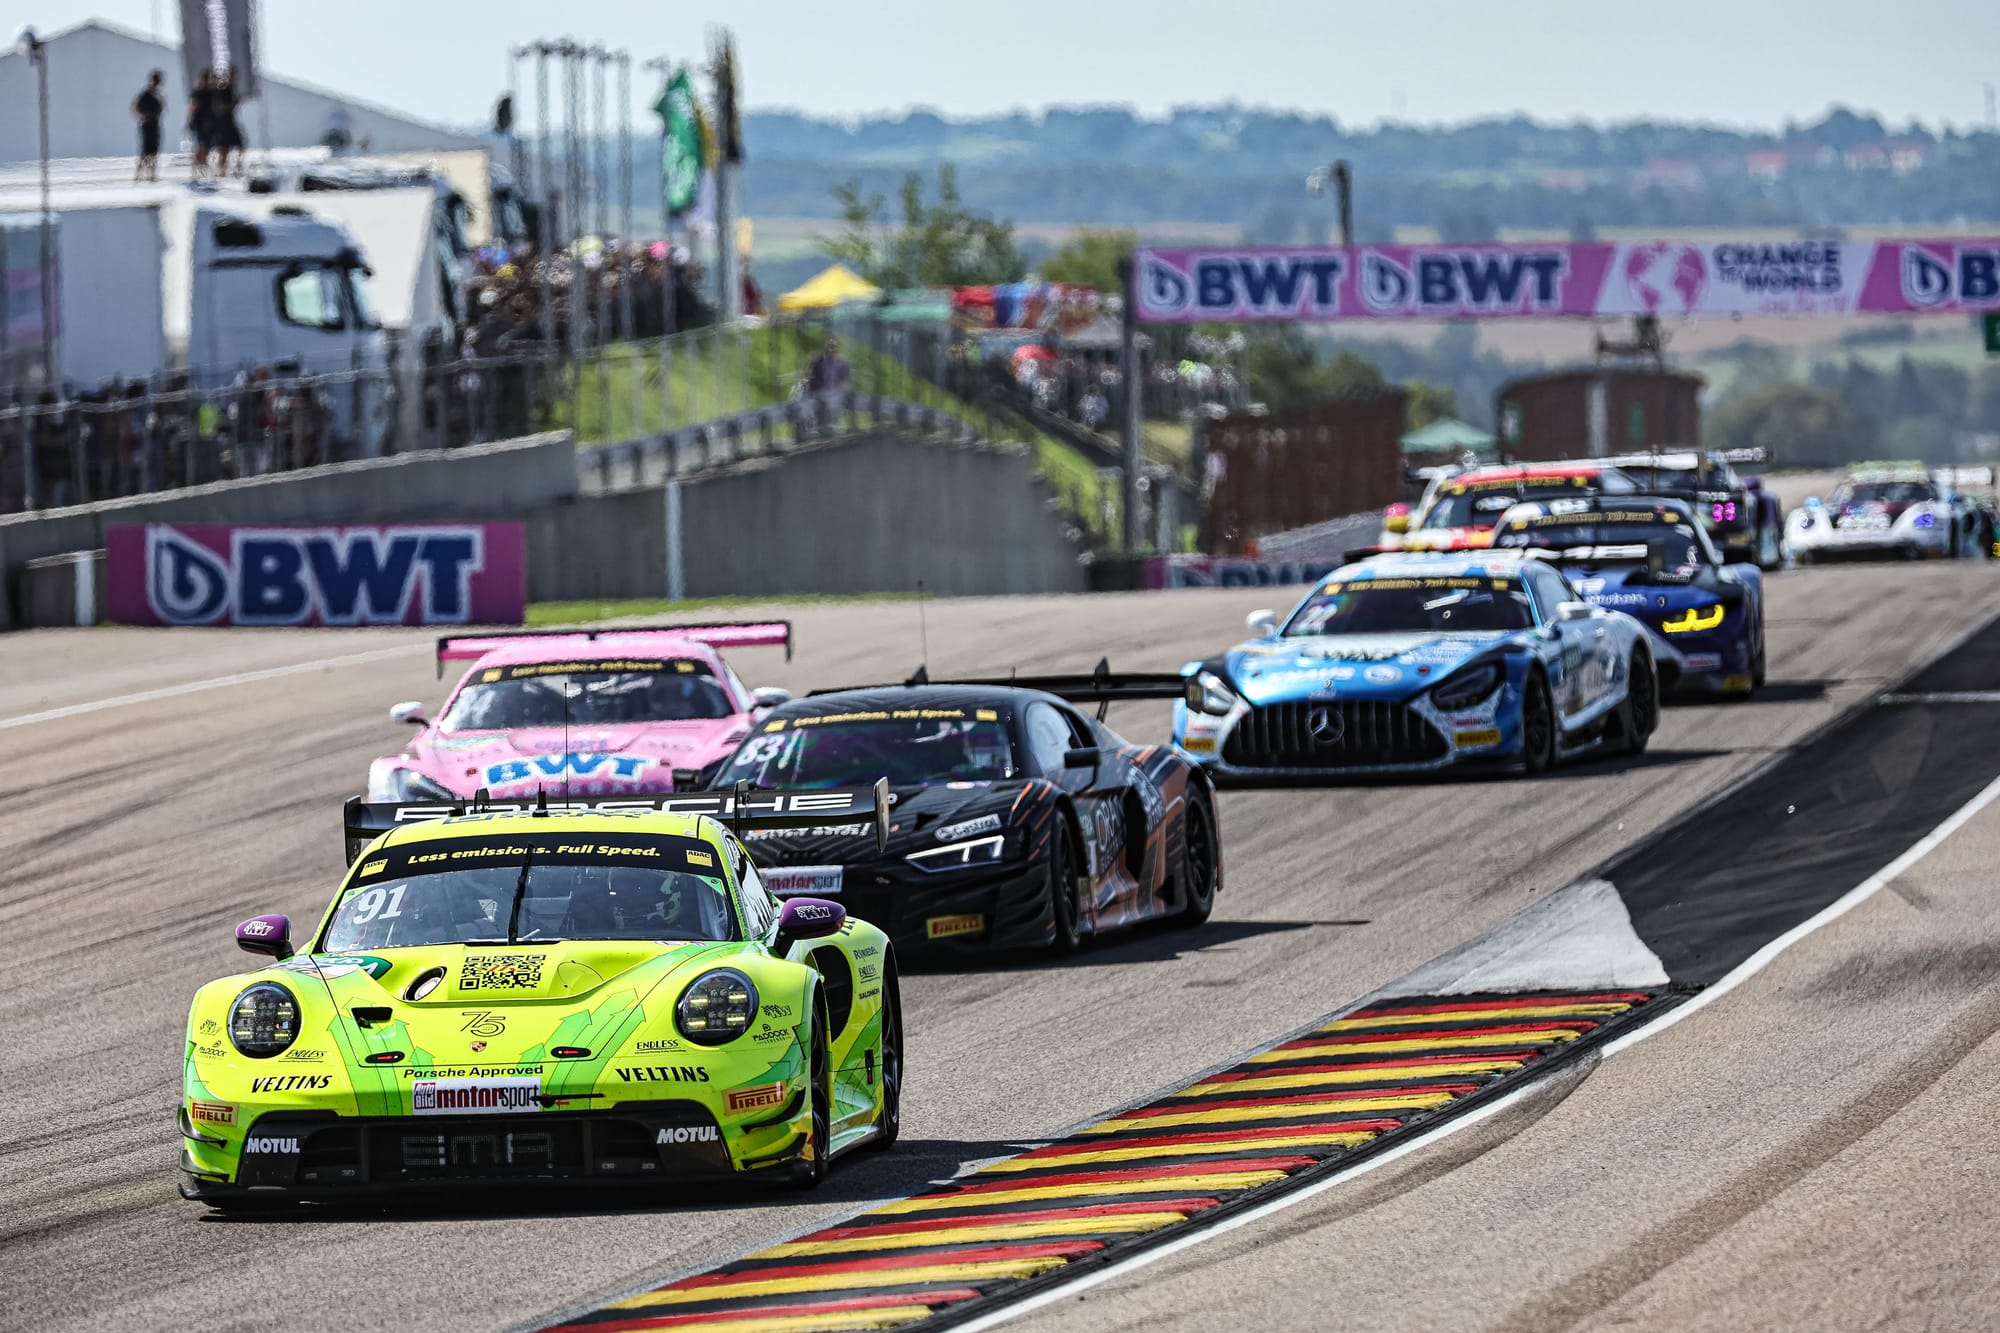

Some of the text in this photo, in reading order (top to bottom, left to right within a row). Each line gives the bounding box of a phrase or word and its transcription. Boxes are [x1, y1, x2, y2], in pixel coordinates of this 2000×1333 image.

[1196, 256, 1344, 308] BWT
[1417, 253, 1565, 308] BWT
[236, 531, 479, 620] BWT
[735, 734, 785, 767] 83
[486, 752, 650, 786] BWT
[408, 852, 448, 864] Less
[557, 845, 594, 854] Full
[596, 846, 661, 857] Speed.
[688, 850, 711, 859] ADAC
[353, 884, 408, 925] 91
[460, 1011, 506, 1037] 75
[636, 1040, 680, 1050] ENDLESS
[404, 1065, 544, 1079] Porsche Approved
[616, 1066, 710, 1082] VELTINS
[251, 1075, 333, 1093] VELTINS
[728, 1085, 784, 1110] PIRELLI
[192, 1102, 234, 1123] PIRELLI
[656, 1126, 719, 1144] MOTUL
[246, 1138, 300, 1154] MOTUL
